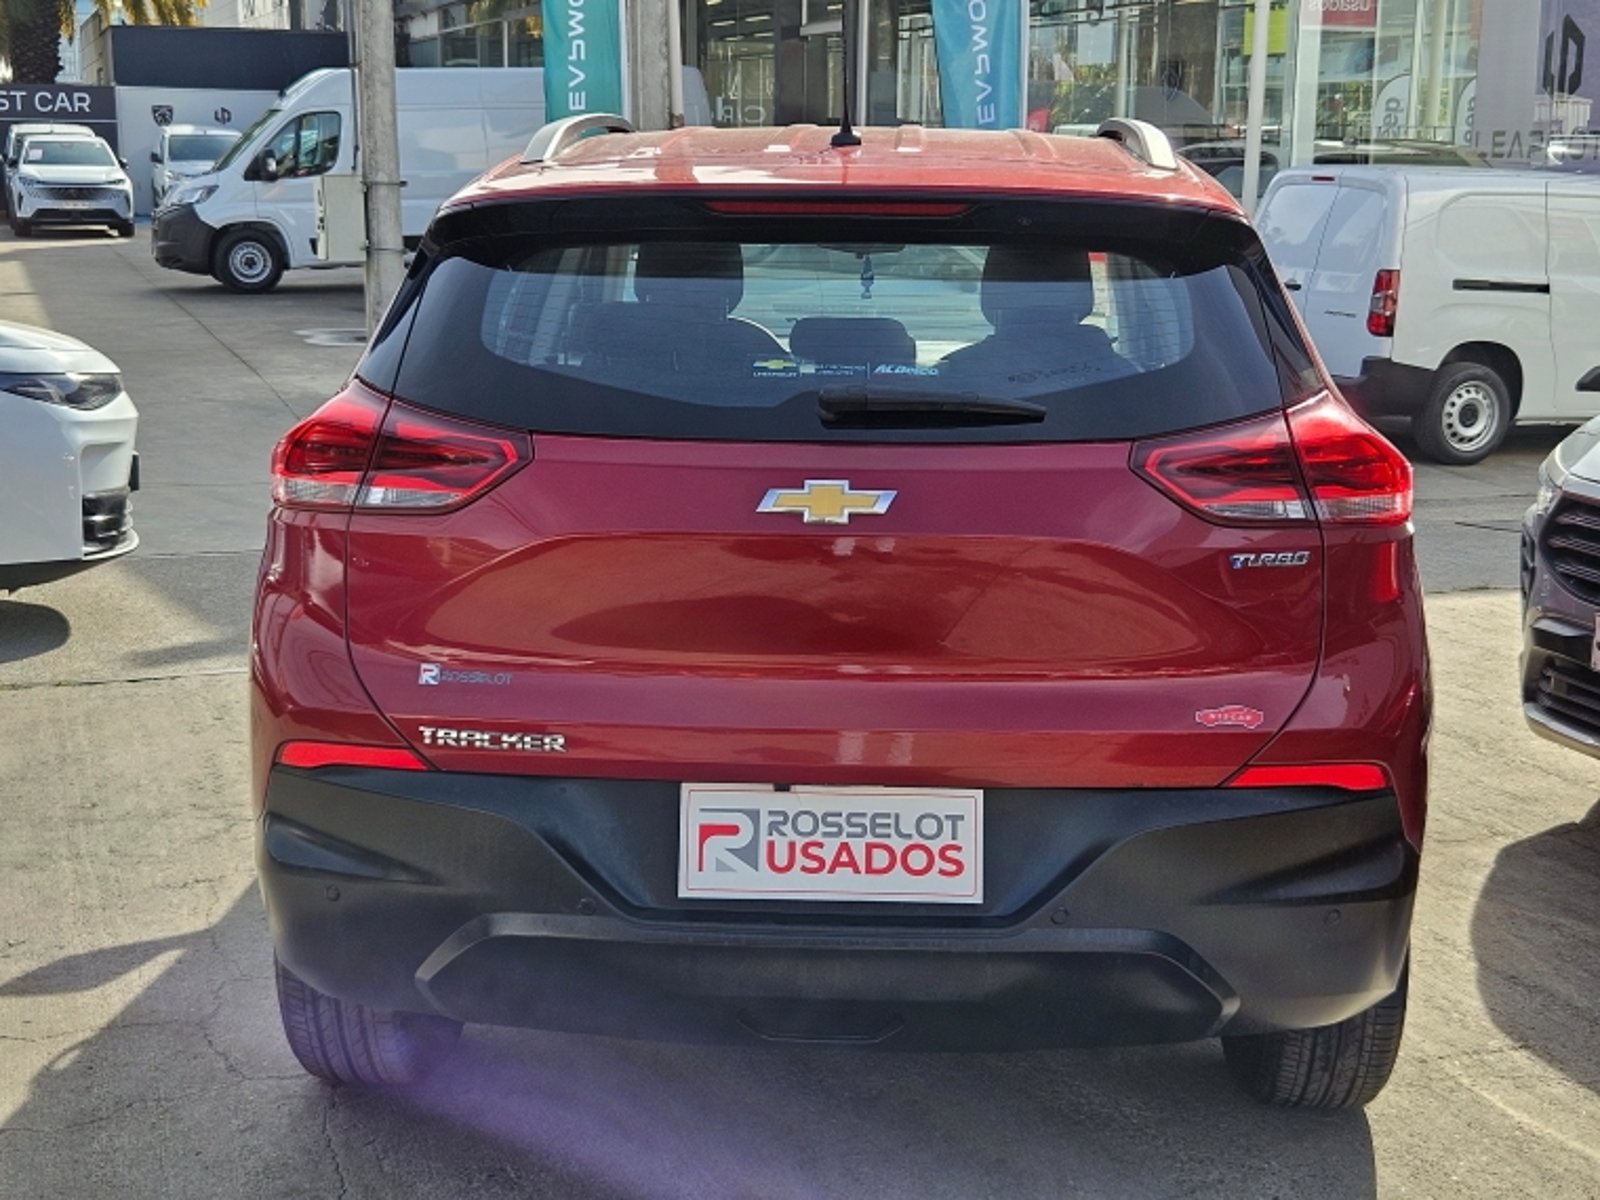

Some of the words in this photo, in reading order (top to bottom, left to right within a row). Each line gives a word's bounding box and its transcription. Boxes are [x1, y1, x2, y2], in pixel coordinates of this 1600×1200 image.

[34, 91, 91, 112] CAR
[1230, 551, 1310, 569] TURBO
[418, 726, 567, 752] TRACKER
[767, 809, 965, 841] ROSSELOT
[765, 839, 966, 878] USADOS
